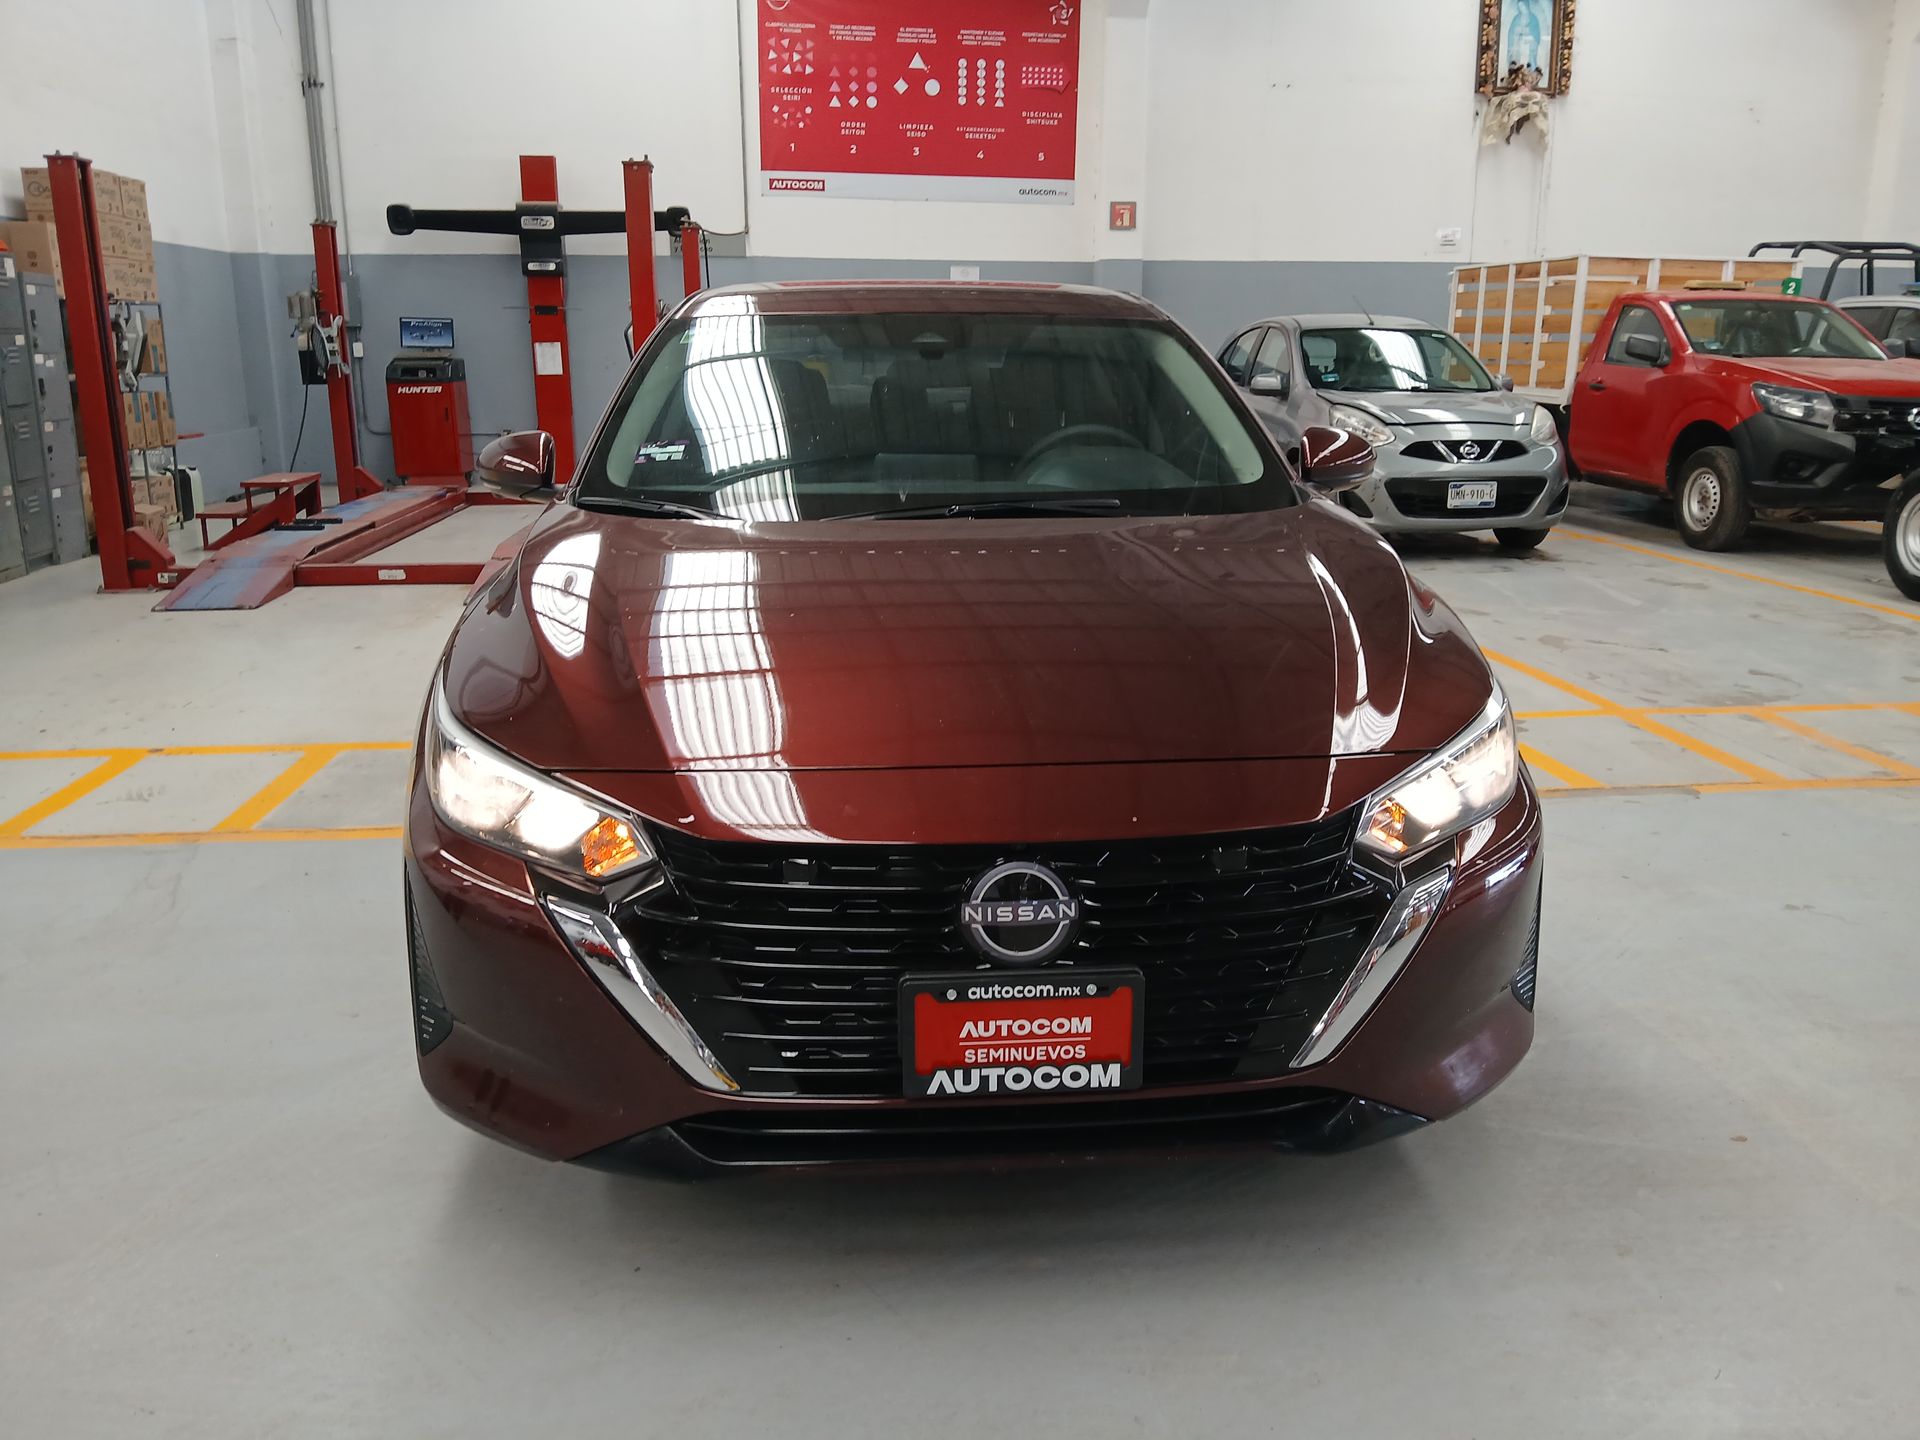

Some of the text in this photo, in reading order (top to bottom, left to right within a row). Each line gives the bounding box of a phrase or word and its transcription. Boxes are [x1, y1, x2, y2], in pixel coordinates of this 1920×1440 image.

[1022, 111, 1063, 119] DISCIPLINA
[840, 128, 865, 136] SEITON
[906, 130, 926, 138] SEISO
[965, 132, 996, 140] SEIKETSU
[789, 143, 795, 152] 1
[850, 145, 857, 154] 2
[913, 147, 920, 156] 3
[976, 150, 984, 159] 4
[1038, 152, 1045, 161] 5
[771, 180, 823, 190] AUTOCOM
[1786, 281, 1796, 295] 2
[397, 386, 443, 394] HUNTER
[965, 902, 1076, 922] NISSAN
[968, 984, 1081, 1000] autocom.mx
[959, 1016, 1092, 1039] AUTOCOM
[964, 1044, 1086, 1064] SEMINUEVOS
[926, 1062, 1121, 1096] AUTOCOM
